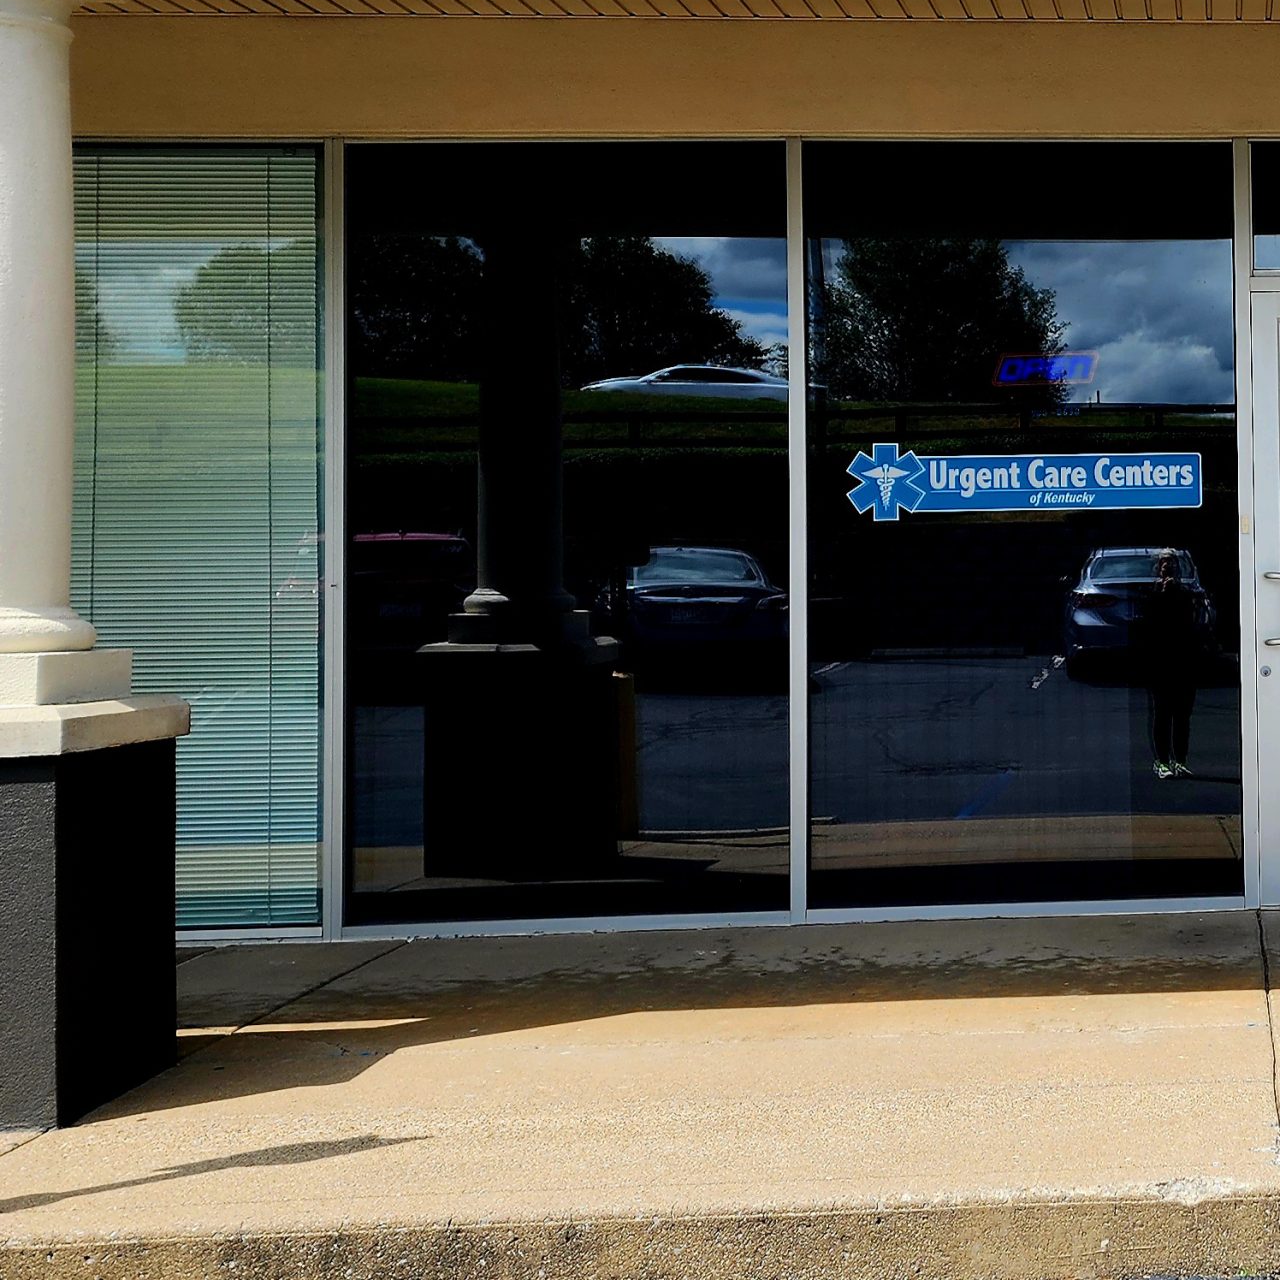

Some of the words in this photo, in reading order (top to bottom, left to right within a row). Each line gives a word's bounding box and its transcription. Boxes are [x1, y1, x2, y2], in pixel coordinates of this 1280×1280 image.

[929, 460, 1021, 497] Urgent
[1027, 459, 1087, 487] Care
[1094, 458, 1193, 486] Centers
[1029, 491, 1042, 506] of
[1044, 490, 1096, 506] Kentucky
